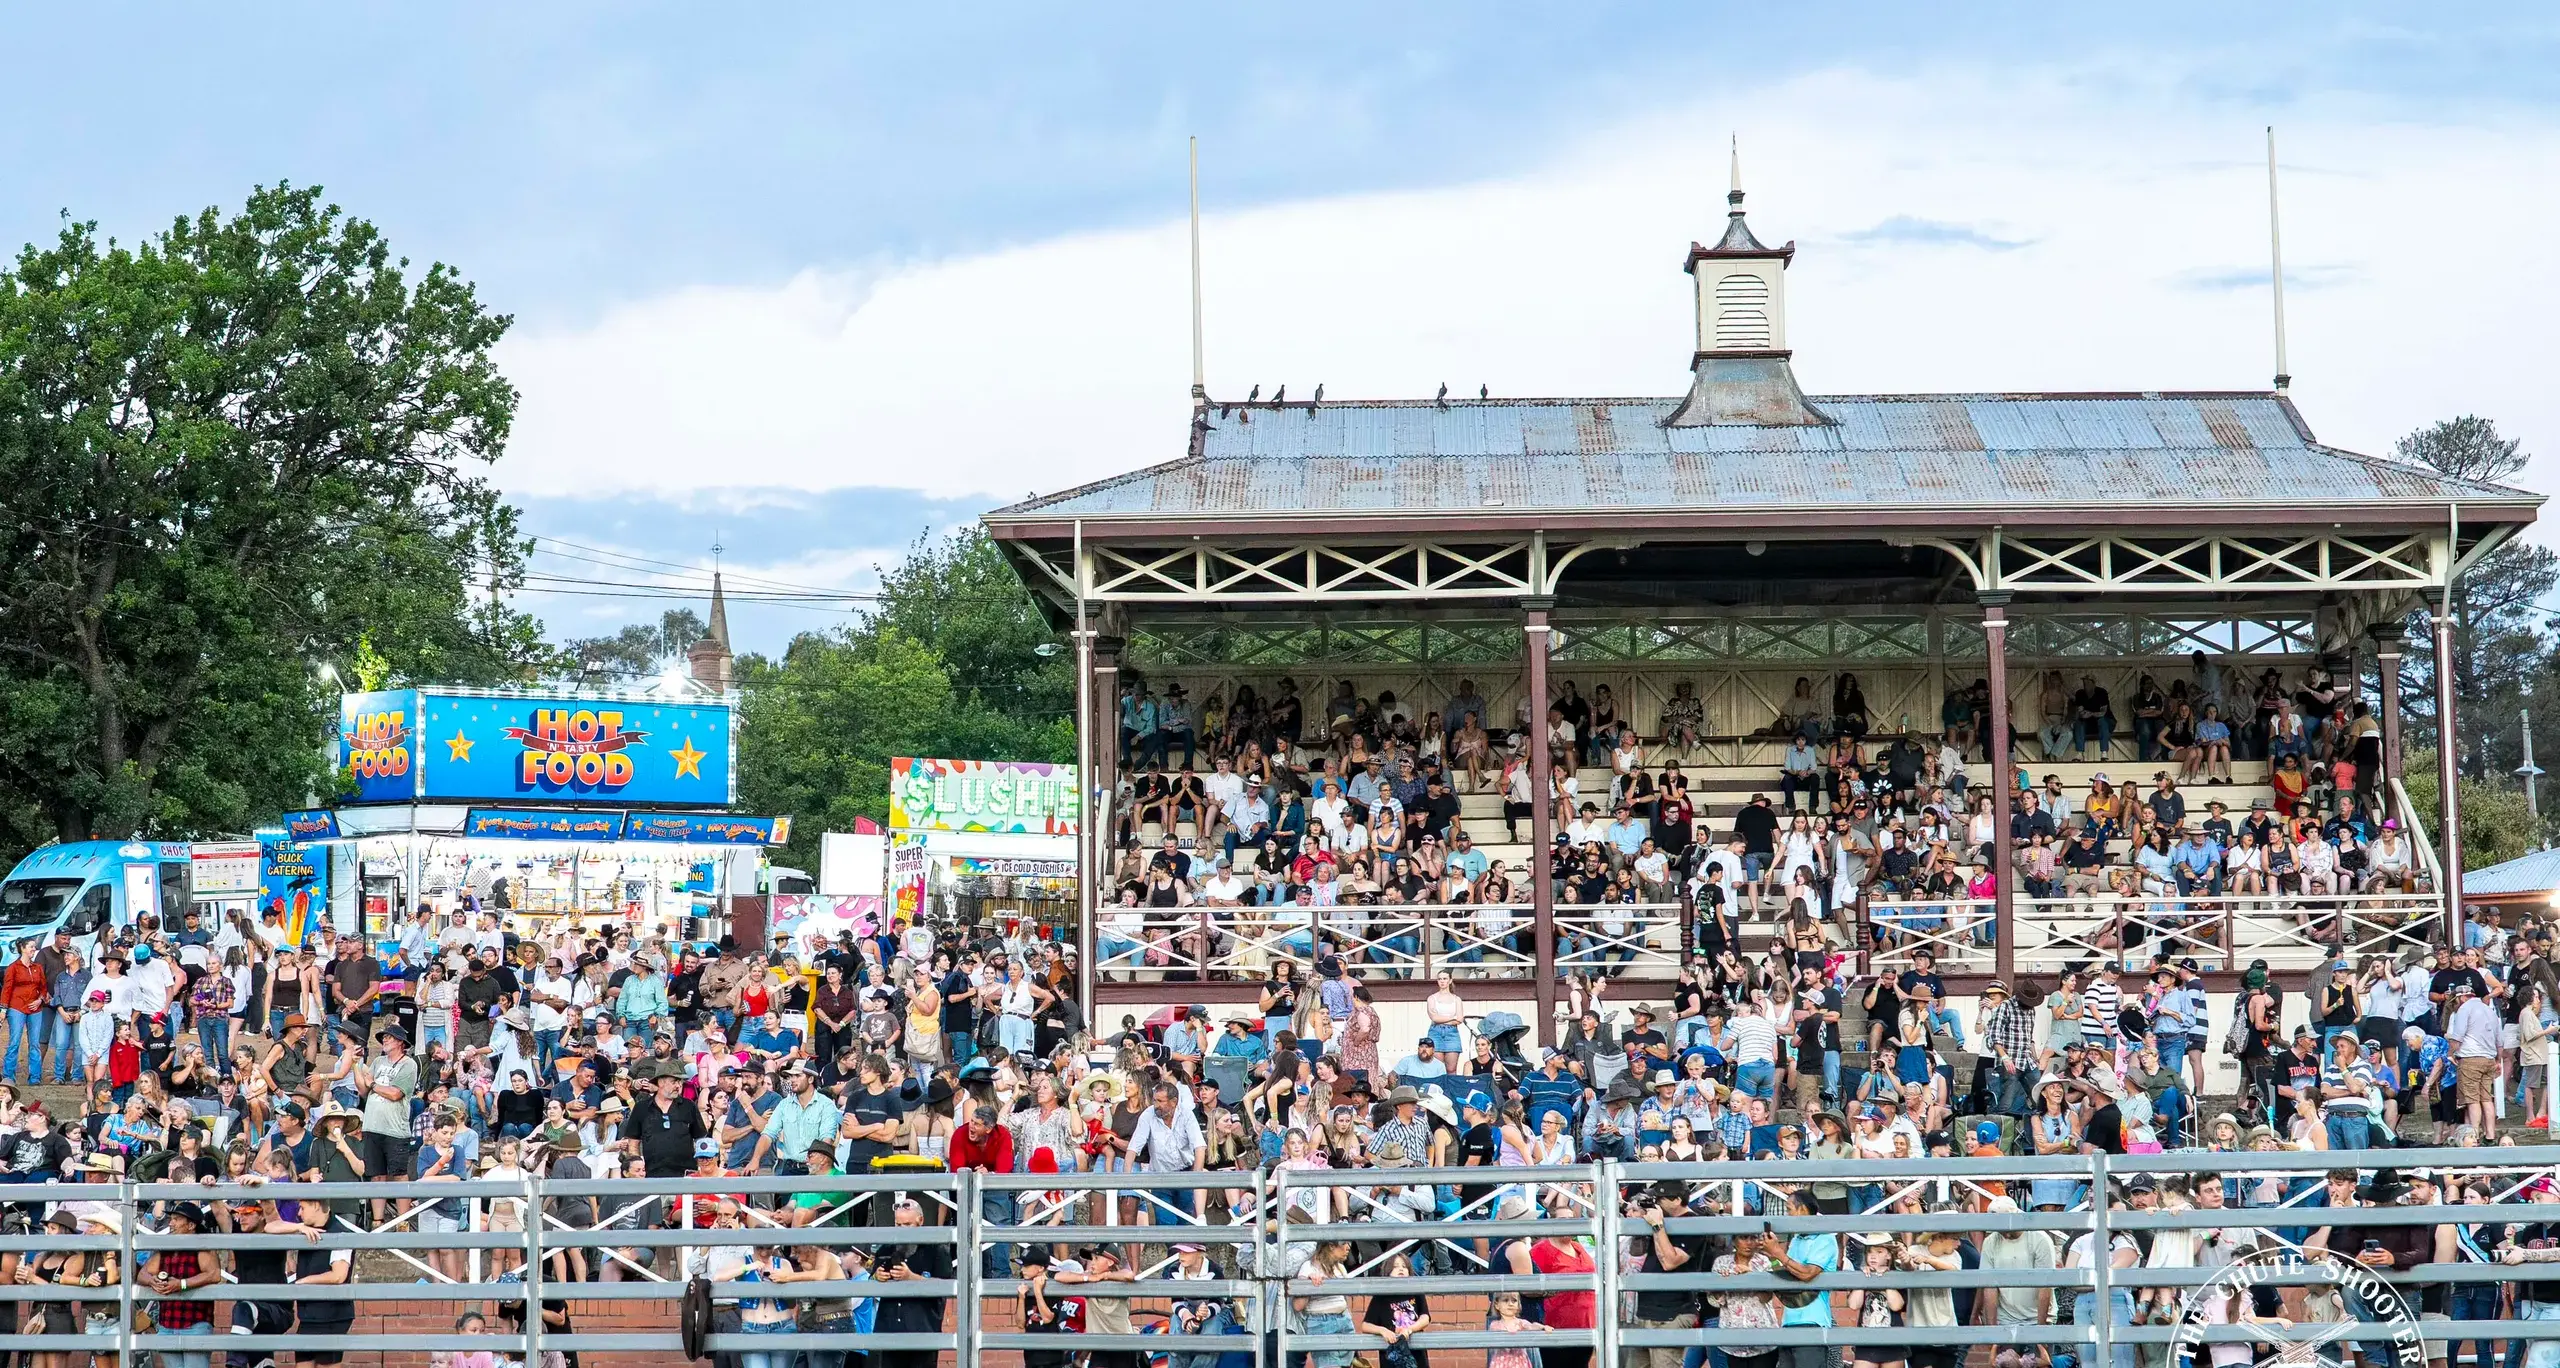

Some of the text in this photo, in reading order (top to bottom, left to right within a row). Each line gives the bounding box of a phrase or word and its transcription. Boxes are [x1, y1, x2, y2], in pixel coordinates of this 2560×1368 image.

[357, 710, 405, 742] HOT
[536, 708, 624, 744] HOT
[564, 744, 598, 753] TASTY
[349, 746, 409, 779] FOOD
[523, 751, 634, 786] FOOD
[551, 822, 572, 832] HOT
[707, 823, 727, 833] HOT
[161, 845, 185, 857] CHOC
[273, 840, 292, 851] LET
[277, 853, 304, 863] BUCK
[895, 846, 923, 862] SUPER
[267, 865, 314, 876] CATERING
[895, 860, 923, 873] SIPPERS
[1001, 862, 1065, 874] ICE COLD SLUSHIES
[905, 889, 918, 901] 1/2
[898, 899, 919, 911] PRICE
